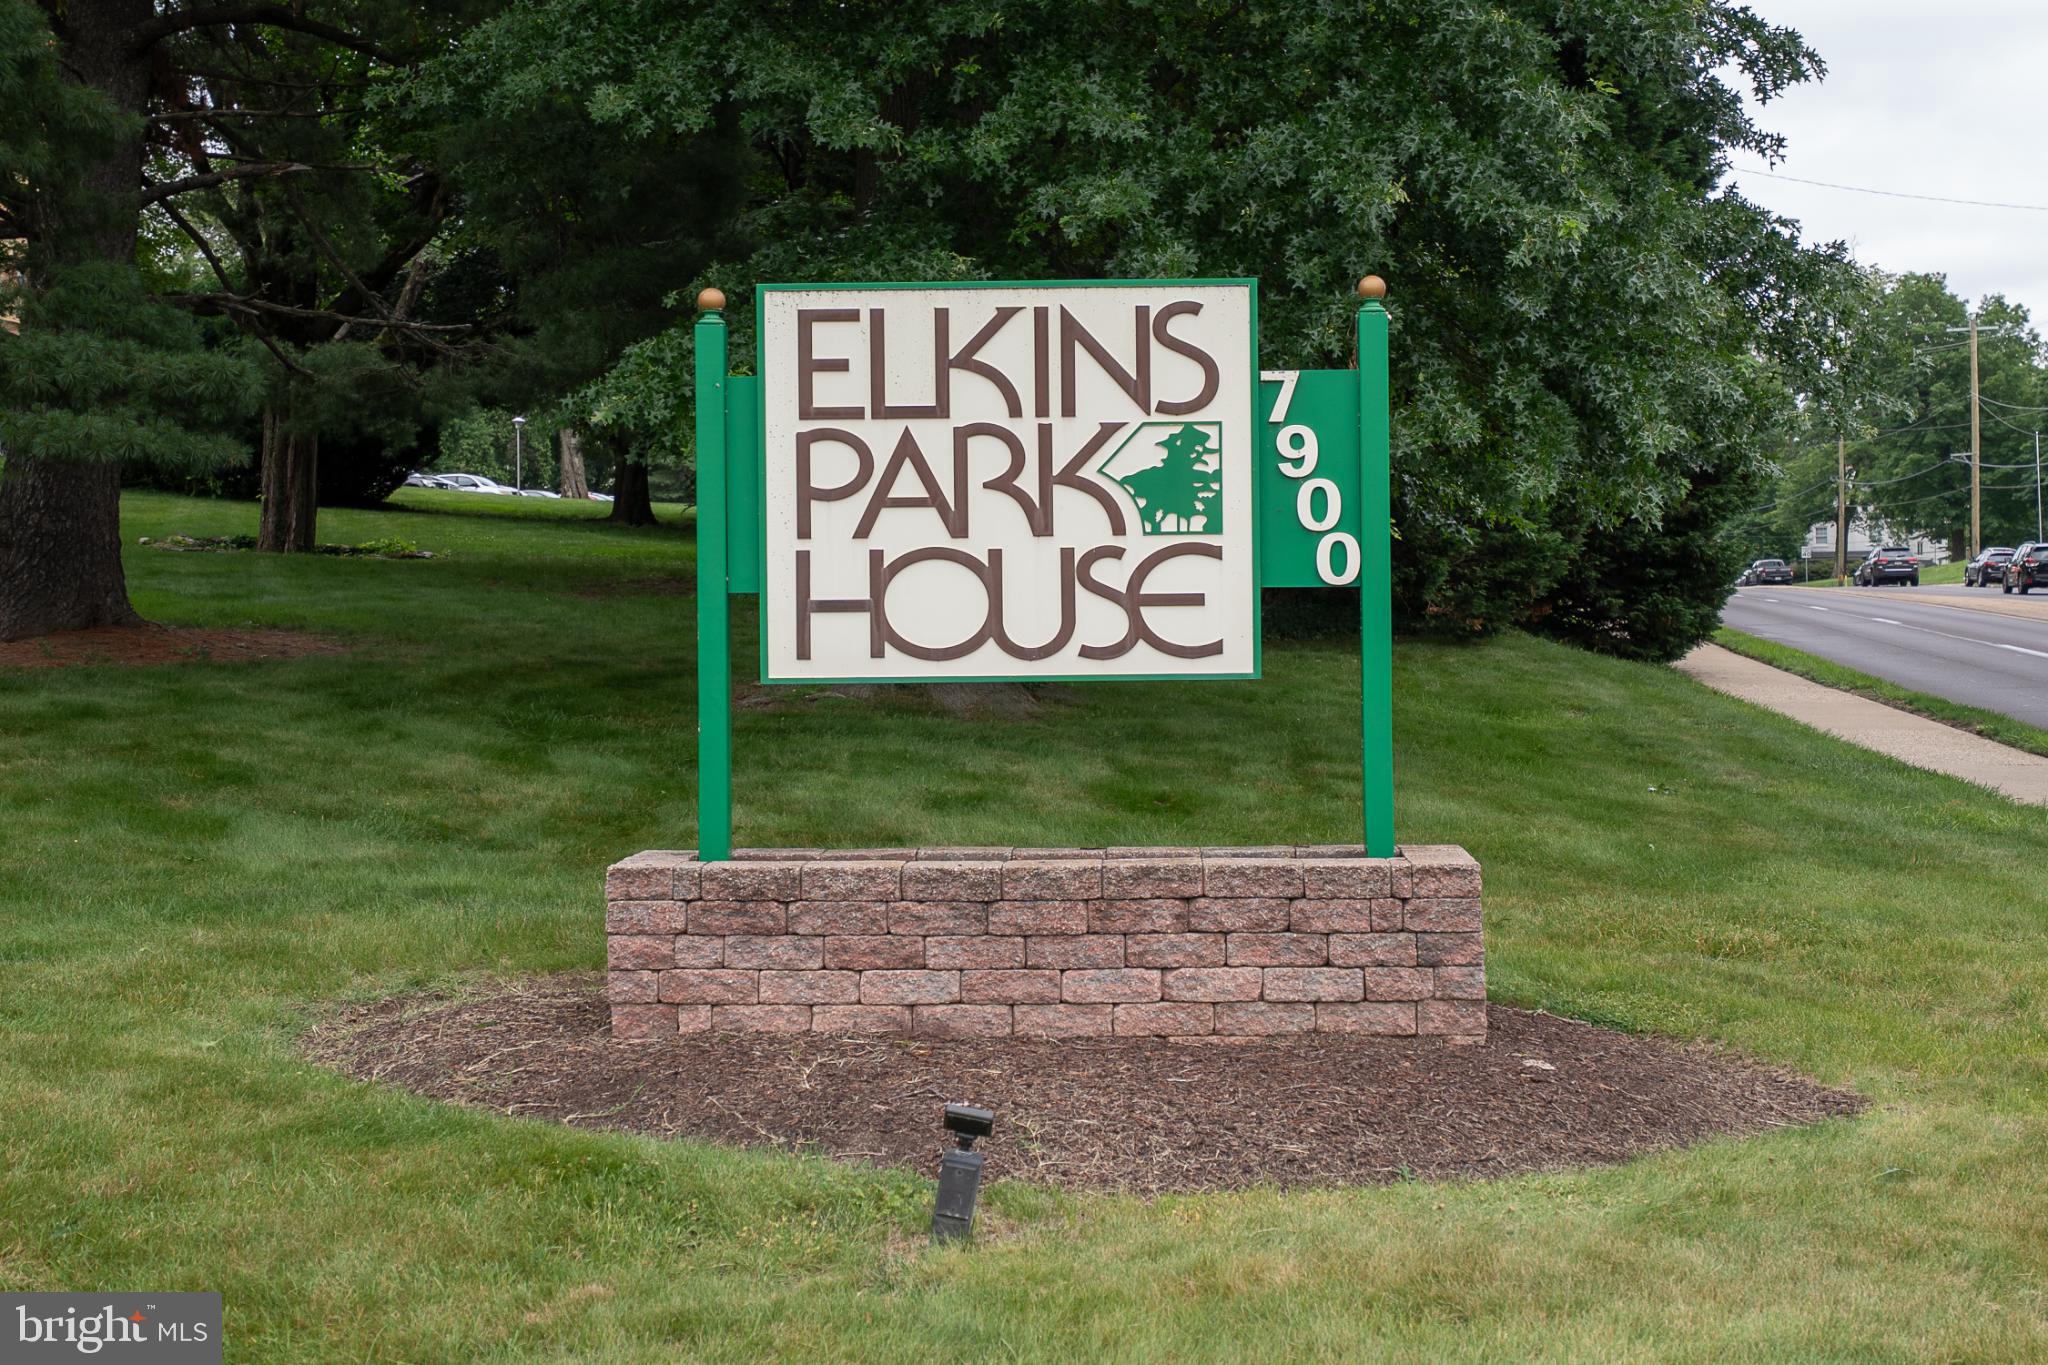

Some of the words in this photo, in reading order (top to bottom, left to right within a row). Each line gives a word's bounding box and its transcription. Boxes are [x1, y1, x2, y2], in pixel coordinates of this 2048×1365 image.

[797, 301, 1220, 420] ELKINS
[795, 422, 1130, 539] PARK
[1259, 370, 1361, 586] 7900
[796, 542, 1223, 661] HOUSE
